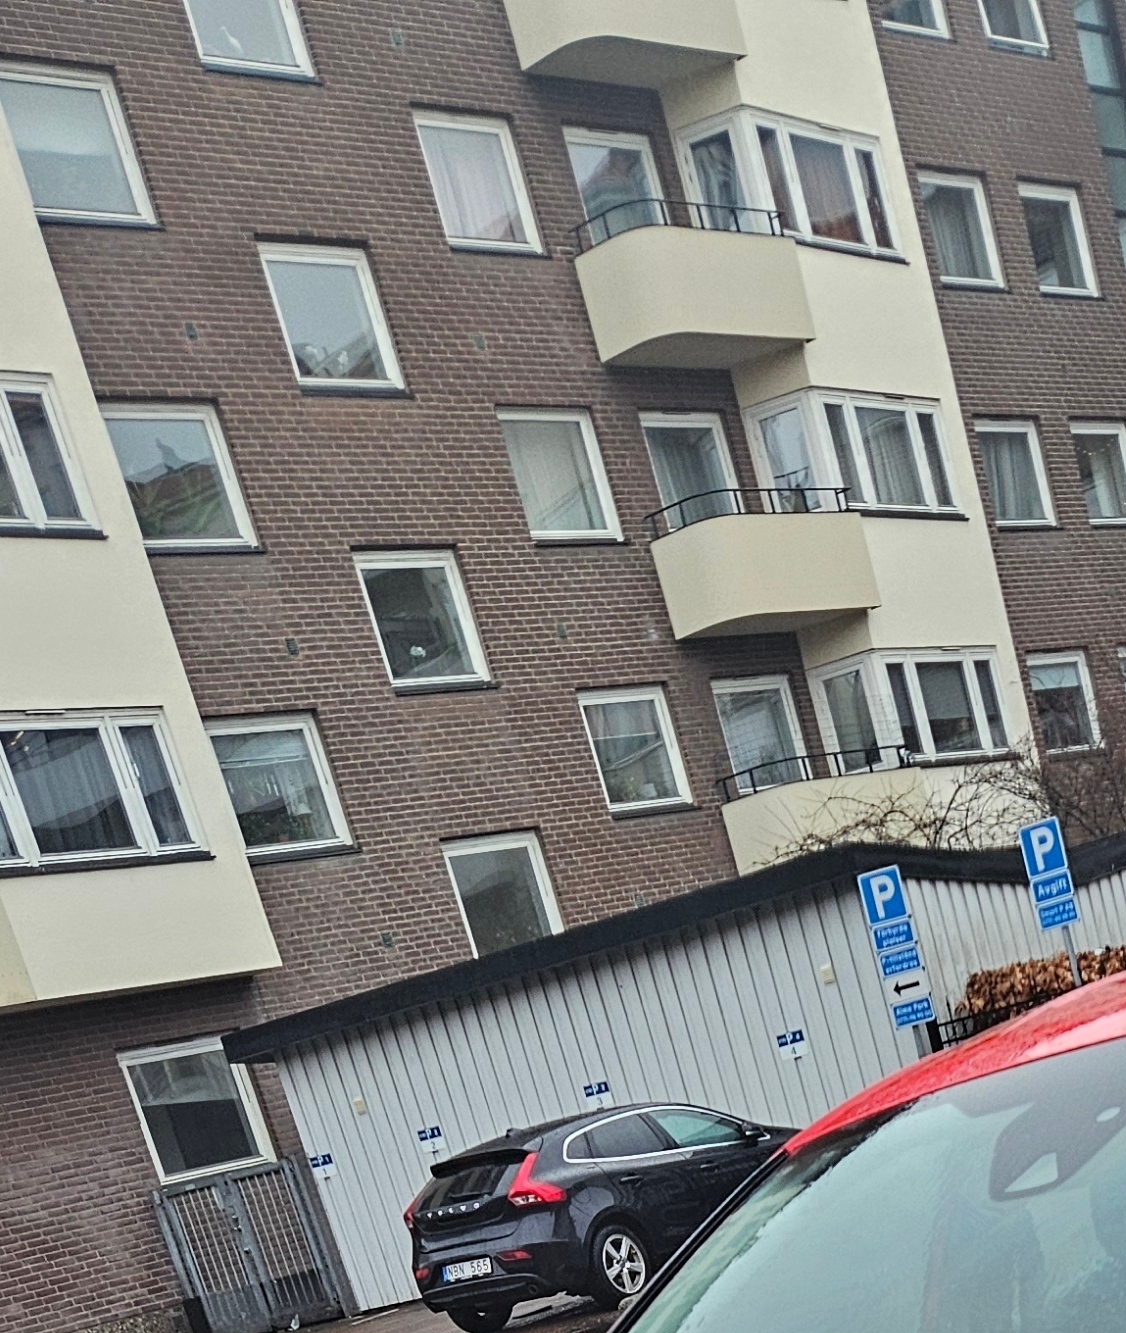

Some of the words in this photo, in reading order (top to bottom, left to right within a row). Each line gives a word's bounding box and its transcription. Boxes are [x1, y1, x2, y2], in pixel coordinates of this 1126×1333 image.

[1030, 826, 1055, 872] P
[869, 874, 895, 919] P
[1037, 877, 1067, 898] Avgift
[427, 1202, 480, 1218] VOLVO
[448, 1264, 465, 1278] NBN
[470, 1259, 489, 1273] 565
